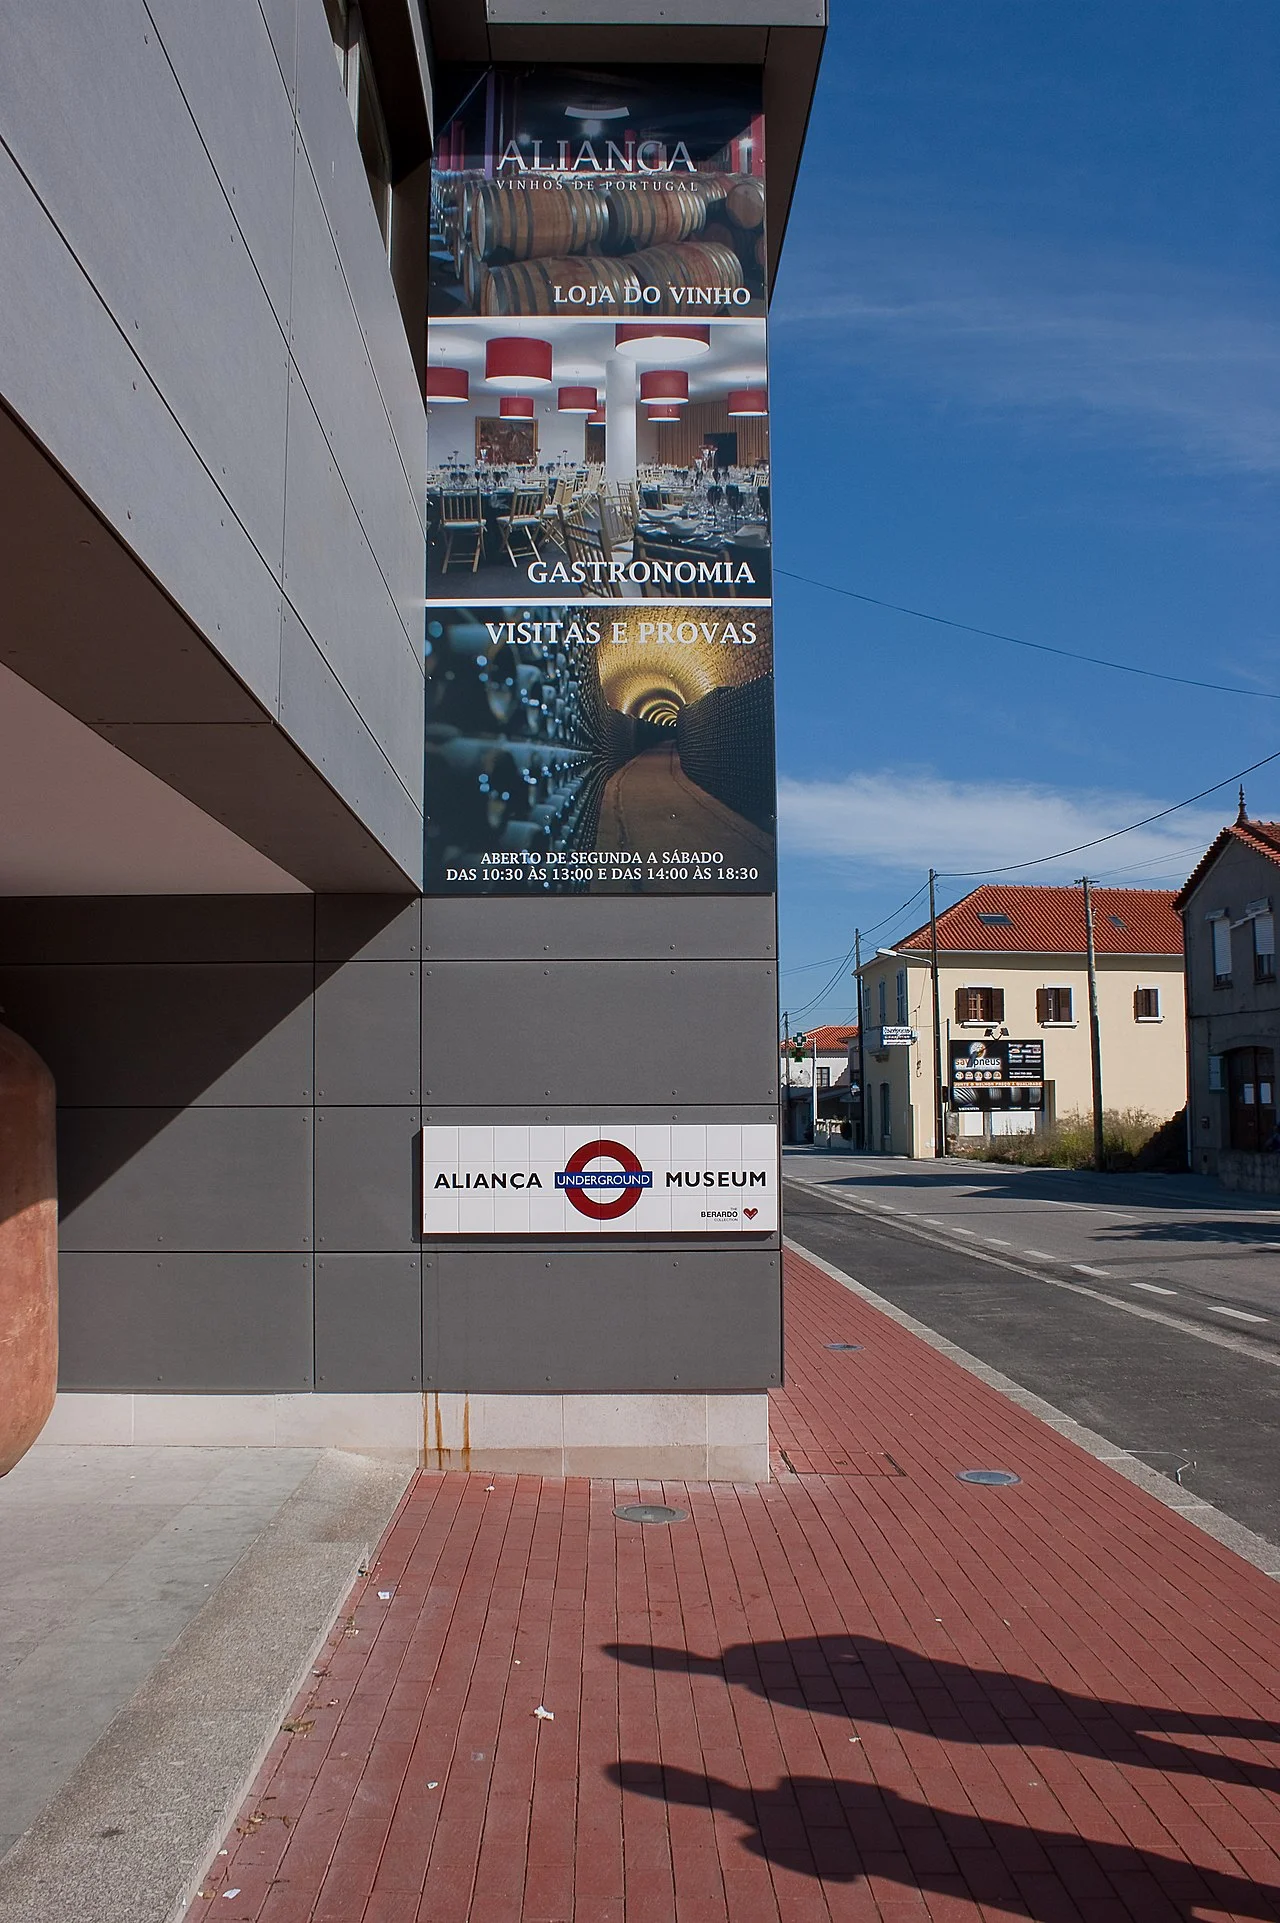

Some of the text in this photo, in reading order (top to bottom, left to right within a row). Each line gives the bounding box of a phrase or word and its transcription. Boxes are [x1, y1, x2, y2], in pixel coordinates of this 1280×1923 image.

[496, 139, 698, 175] ALIANÇA
[496, 180, 698, 192] VINHOS DE PORTUGAL
[553, 285, 751, 306] LOJA DO VINHO
[527, 561, 756, 584] GASTRONOMIA
[485, 622, 757, 645] VISITAS E PROVAS
[480, 849, 724, 865] ABERTO DE SEGUNDA A SÁBADO
[446, 865, 758, 881] DAS 10:30 ÀS 13:00 E DAS 14:00 ÀS 18:30
[433, 1171, 767, 1191] ALIANÇA UNDERGROUND MUSEUM
[700, 1210, 738, 1218] BERARDO
